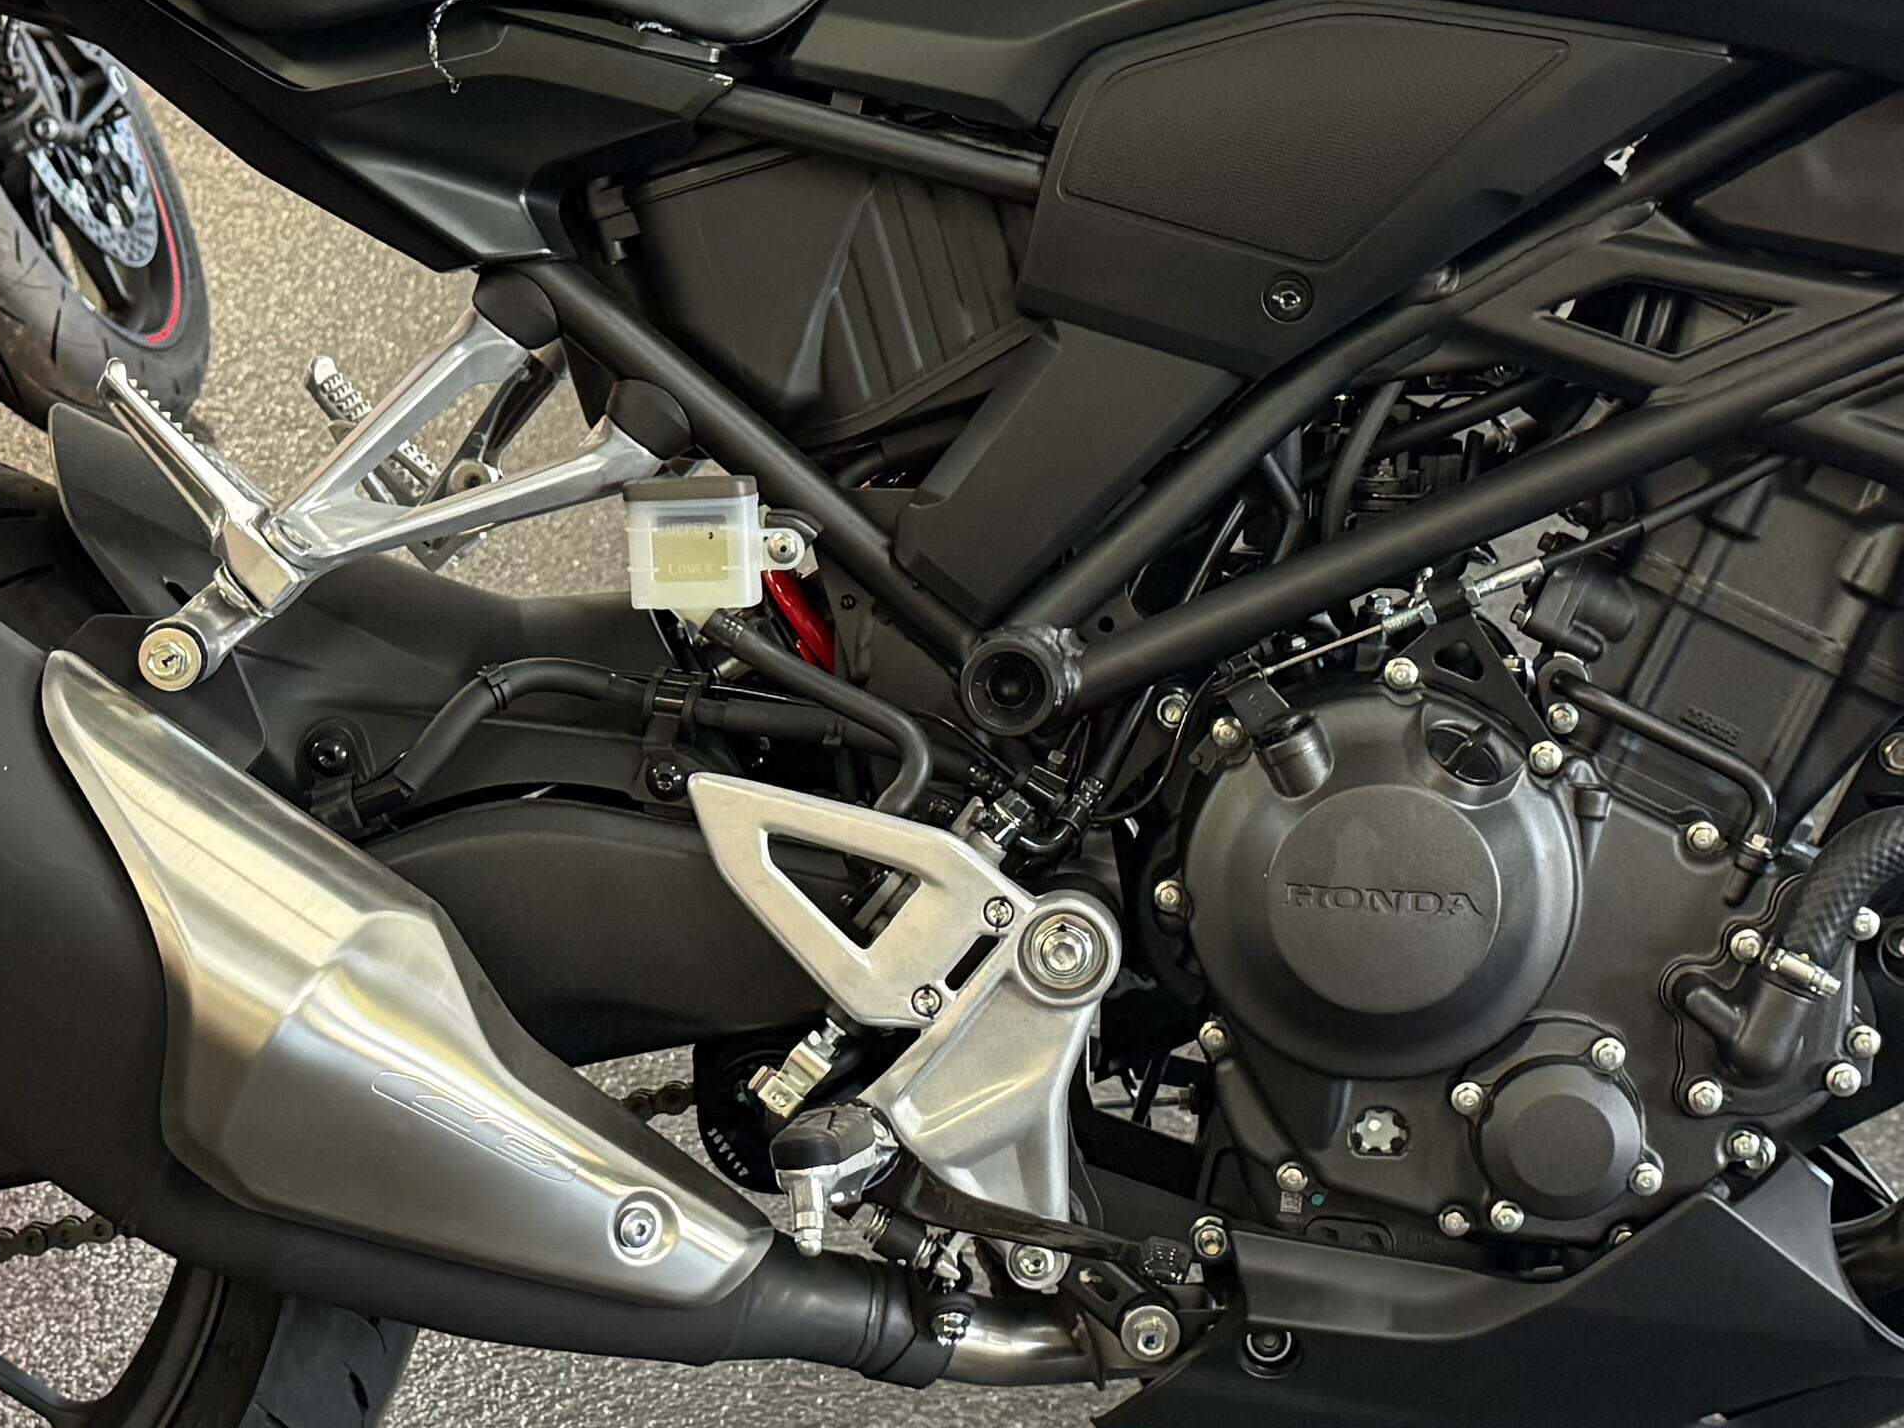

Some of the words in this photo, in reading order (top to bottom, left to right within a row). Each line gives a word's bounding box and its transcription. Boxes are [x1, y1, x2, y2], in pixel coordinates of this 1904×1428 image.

[665, 522, 713, 536] UPPER
[667, 562, 716, 575] LOWER
[1284, 882, 1485, 917] HONDA
